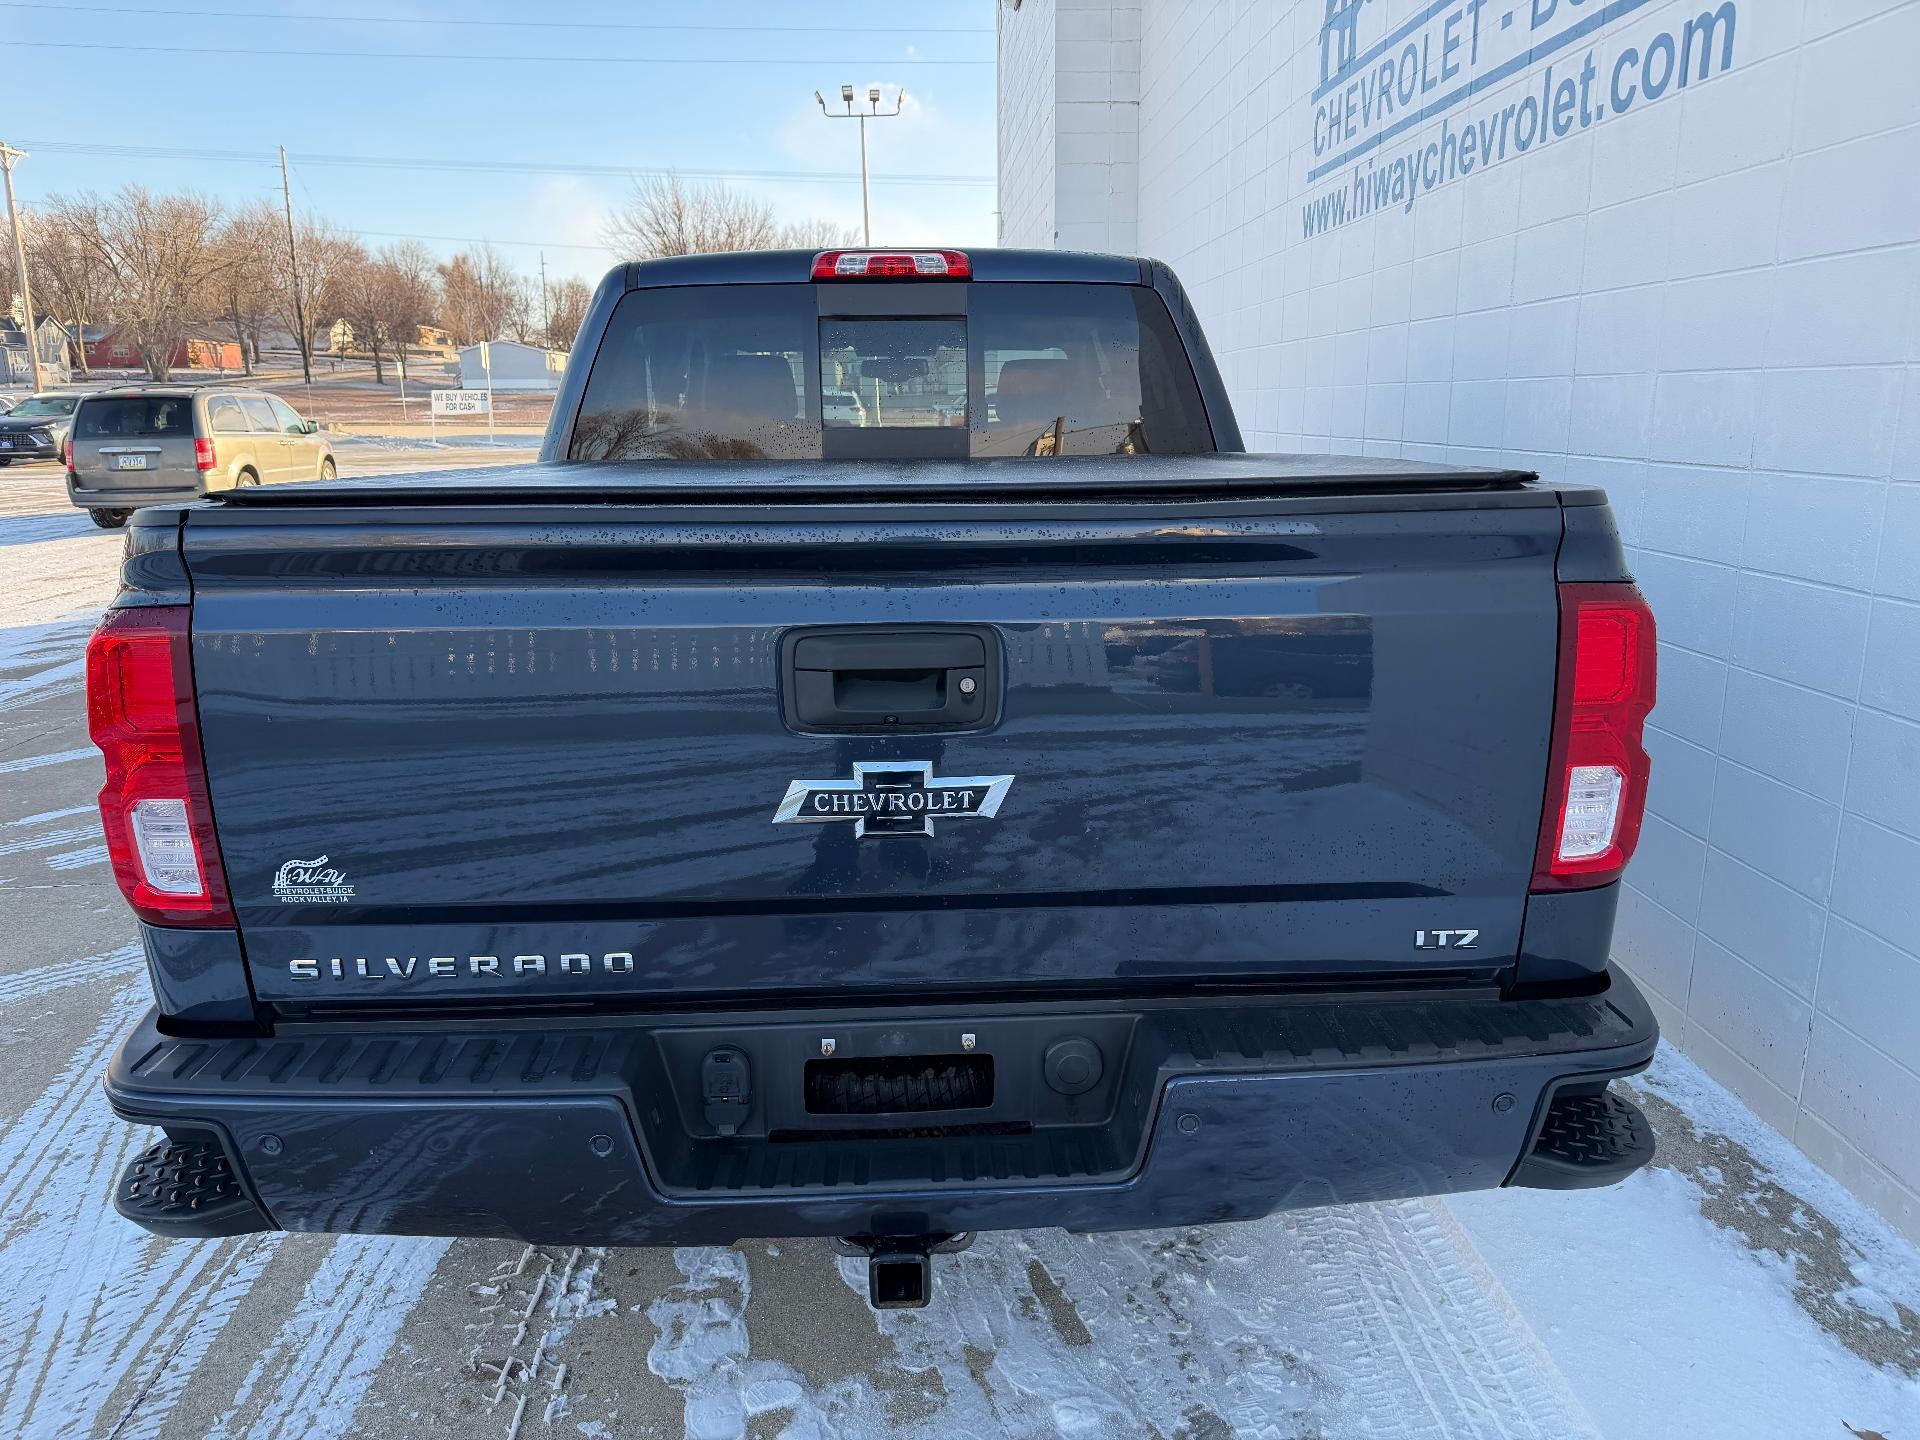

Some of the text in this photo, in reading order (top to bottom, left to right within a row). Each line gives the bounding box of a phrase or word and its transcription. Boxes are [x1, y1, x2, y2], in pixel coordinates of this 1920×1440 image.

[1314, 0, 1488, 157] CHEVROLET
[1302, 1, 1736, 239] www.hiwaychevrolet.com
[434, 393, 488, 401] WE BUY VEHICLES
[445, 403, 475, 411] FOR CASH
[814, 791, 974, 812] CHEVROLET
[306, 896, 339, 904] VALLEY,
[1415, 929, 1479, 949] LTZ
[289, 952, 635, 980] SILVERADO
